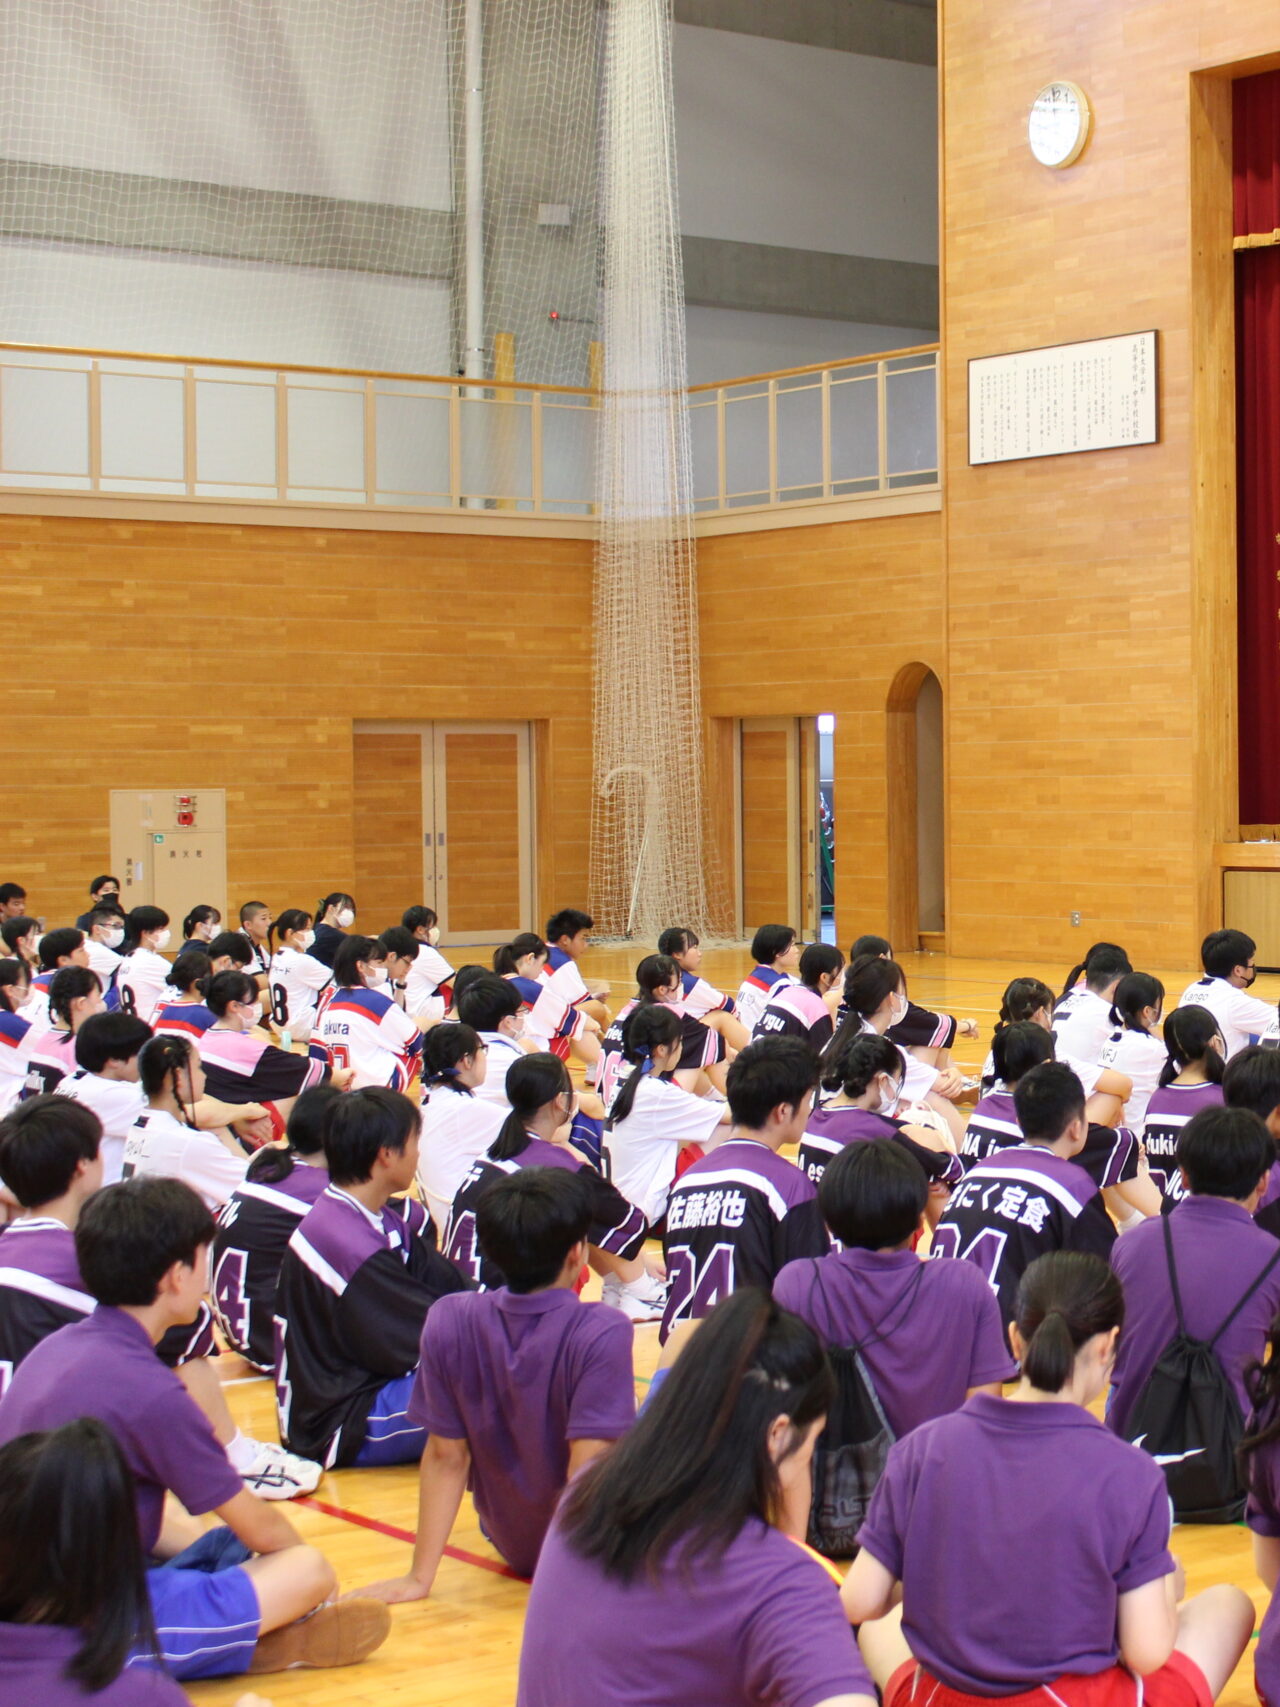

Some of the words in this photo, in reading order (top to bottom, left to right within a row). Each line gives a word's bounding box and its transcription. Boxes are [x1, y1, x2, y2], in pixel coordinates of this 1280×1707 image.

[273, 983, 289, 1026] 8
[667, 1190, 746, 1232] 佐藤裕也
[660, 1242, 735, 1333] 24
